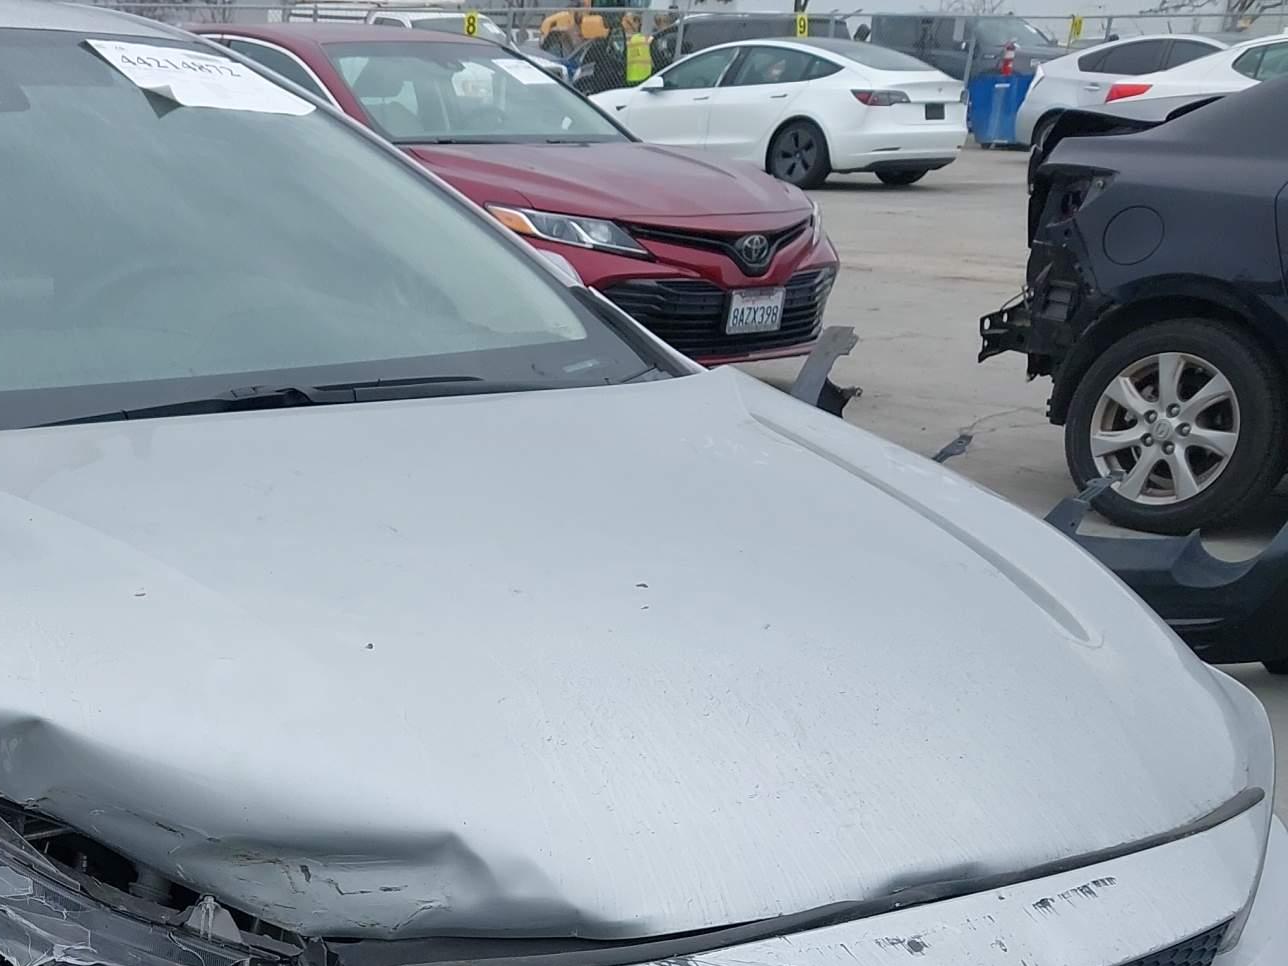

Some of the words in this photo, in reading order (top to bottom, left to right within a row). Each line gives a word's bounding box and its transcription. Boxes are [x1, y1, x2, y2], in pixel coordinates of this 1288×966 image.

[467, 15, 476, 35] 8
[798, 16, 806, 34] 9
[732, 305, 779, 327] 8AZX398
